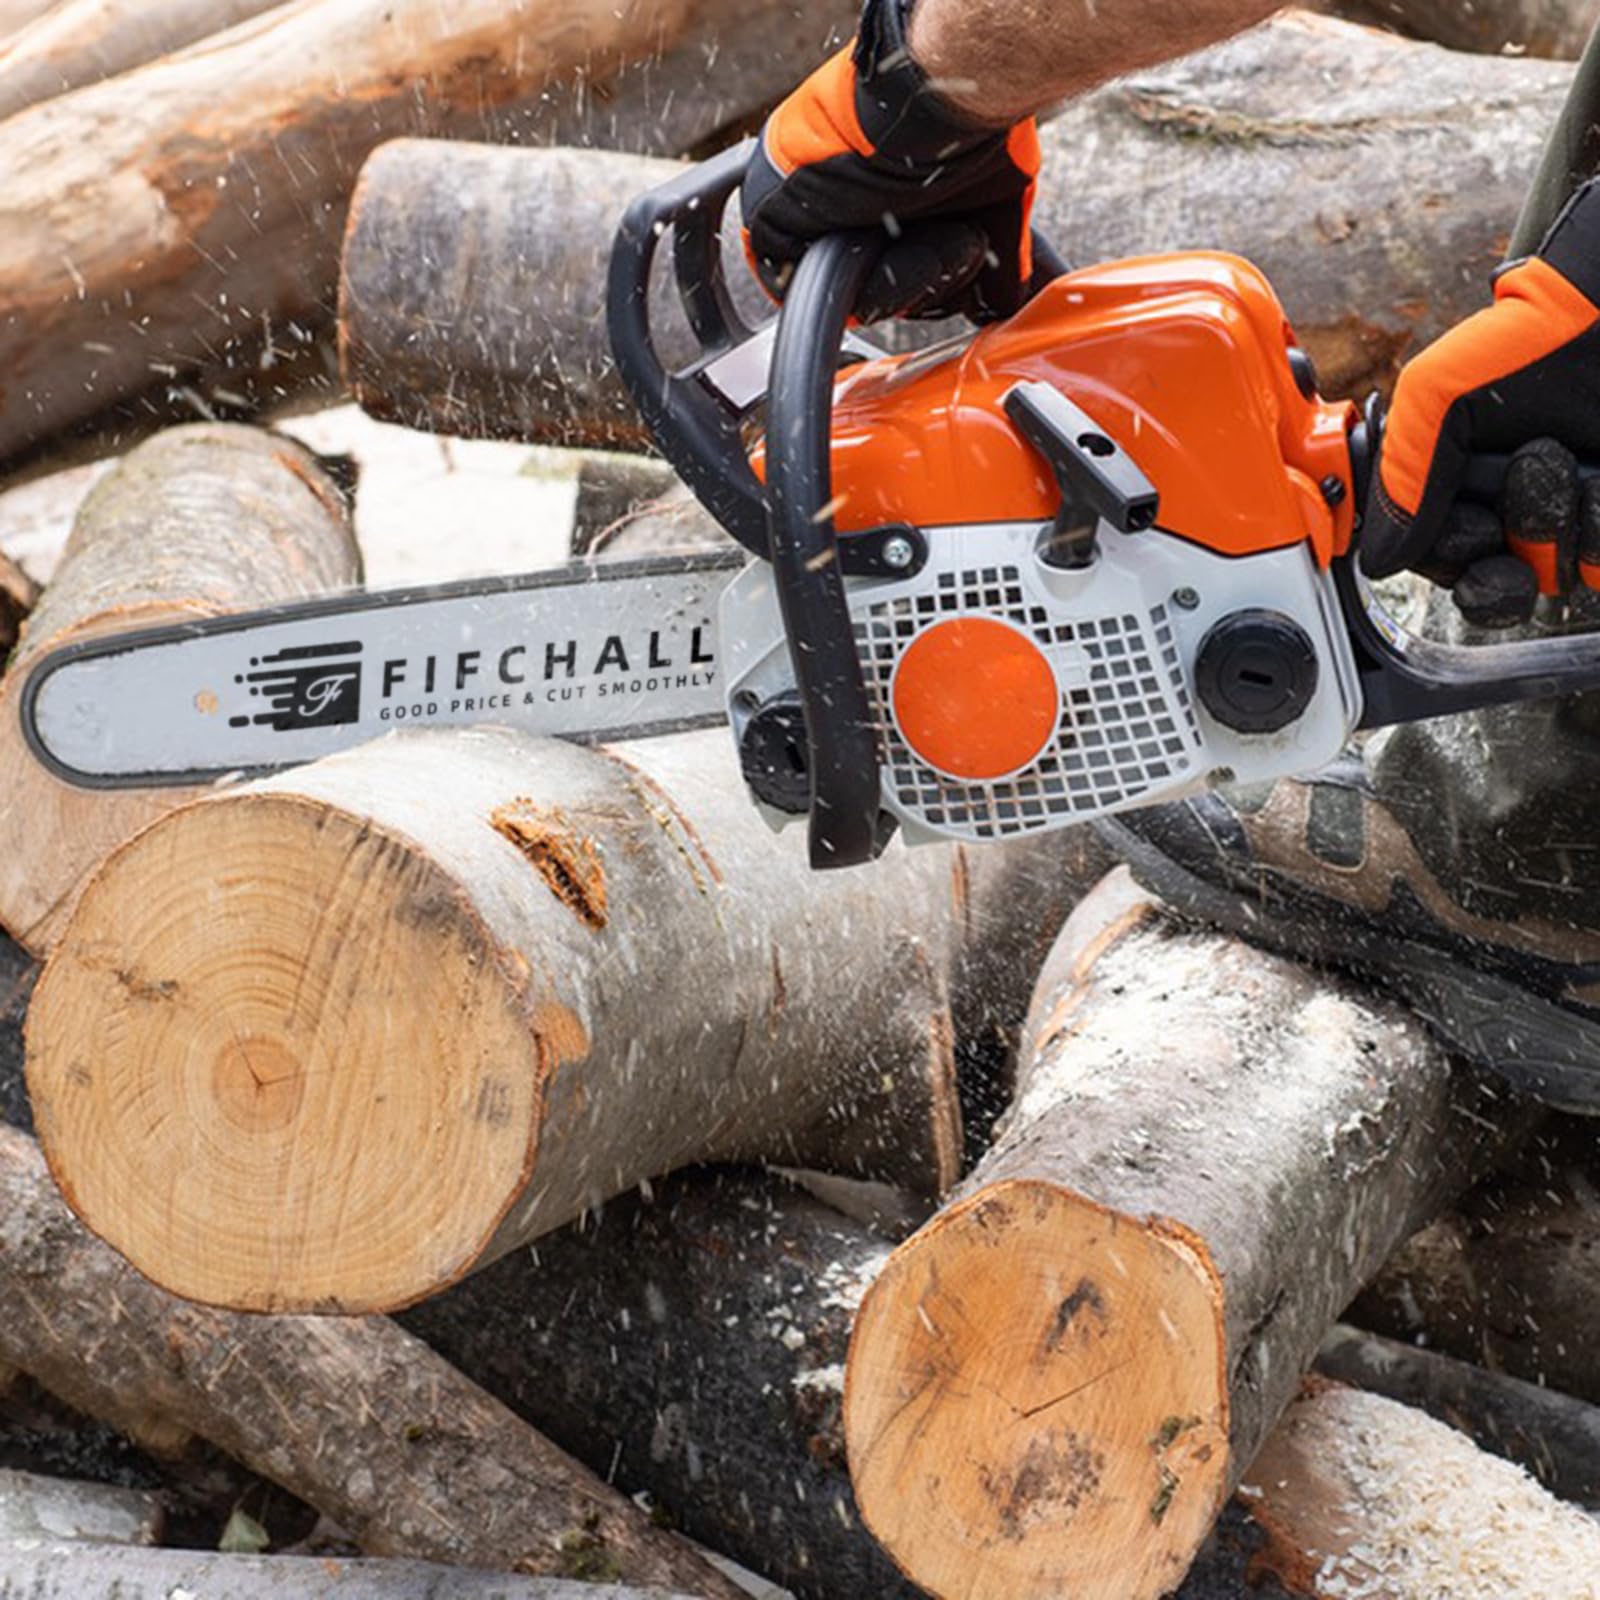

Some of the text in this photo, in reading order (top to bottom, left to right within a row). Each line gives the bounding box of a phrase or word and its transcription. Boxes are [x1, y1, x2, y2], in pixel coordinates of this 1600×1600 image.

[382, 626, 714, 698] FIFCHALL
[380, 671, 715, 721] GOOD PRICE & CUT SMOOTHLY
